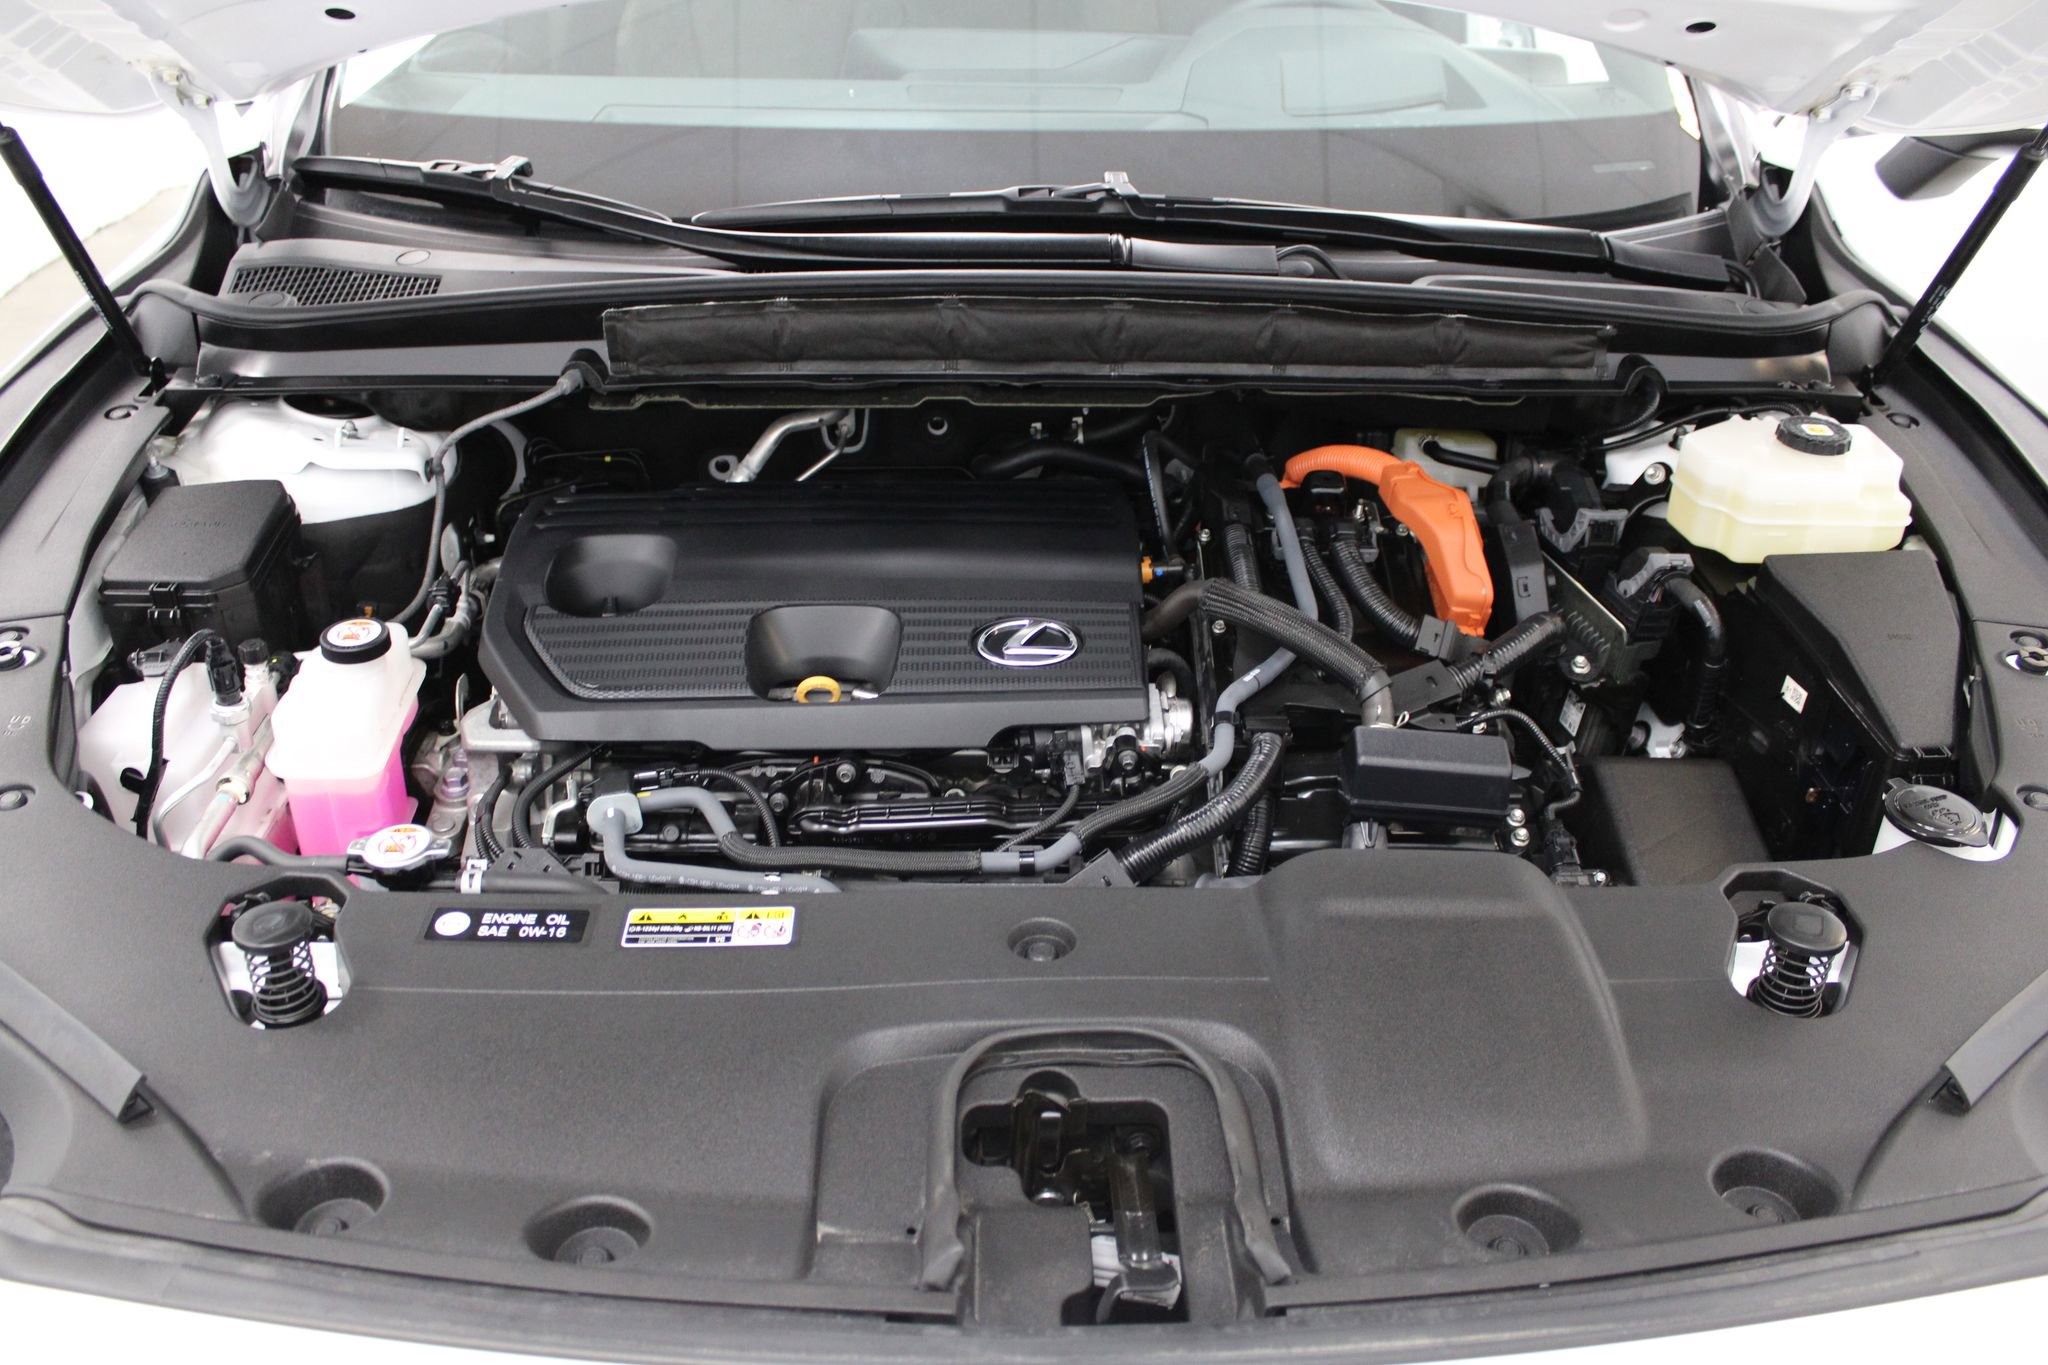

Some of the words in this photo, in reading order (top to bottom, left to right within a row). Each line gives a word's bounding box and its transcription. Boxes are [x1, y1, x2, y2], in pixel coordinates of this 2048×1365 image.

[481, 912, 538, 925] ENGINE
[546, 913, 570, 926] OIL
[477, 925, 509, 937] SAE
[518, 926, 567, 938] 0W-16
